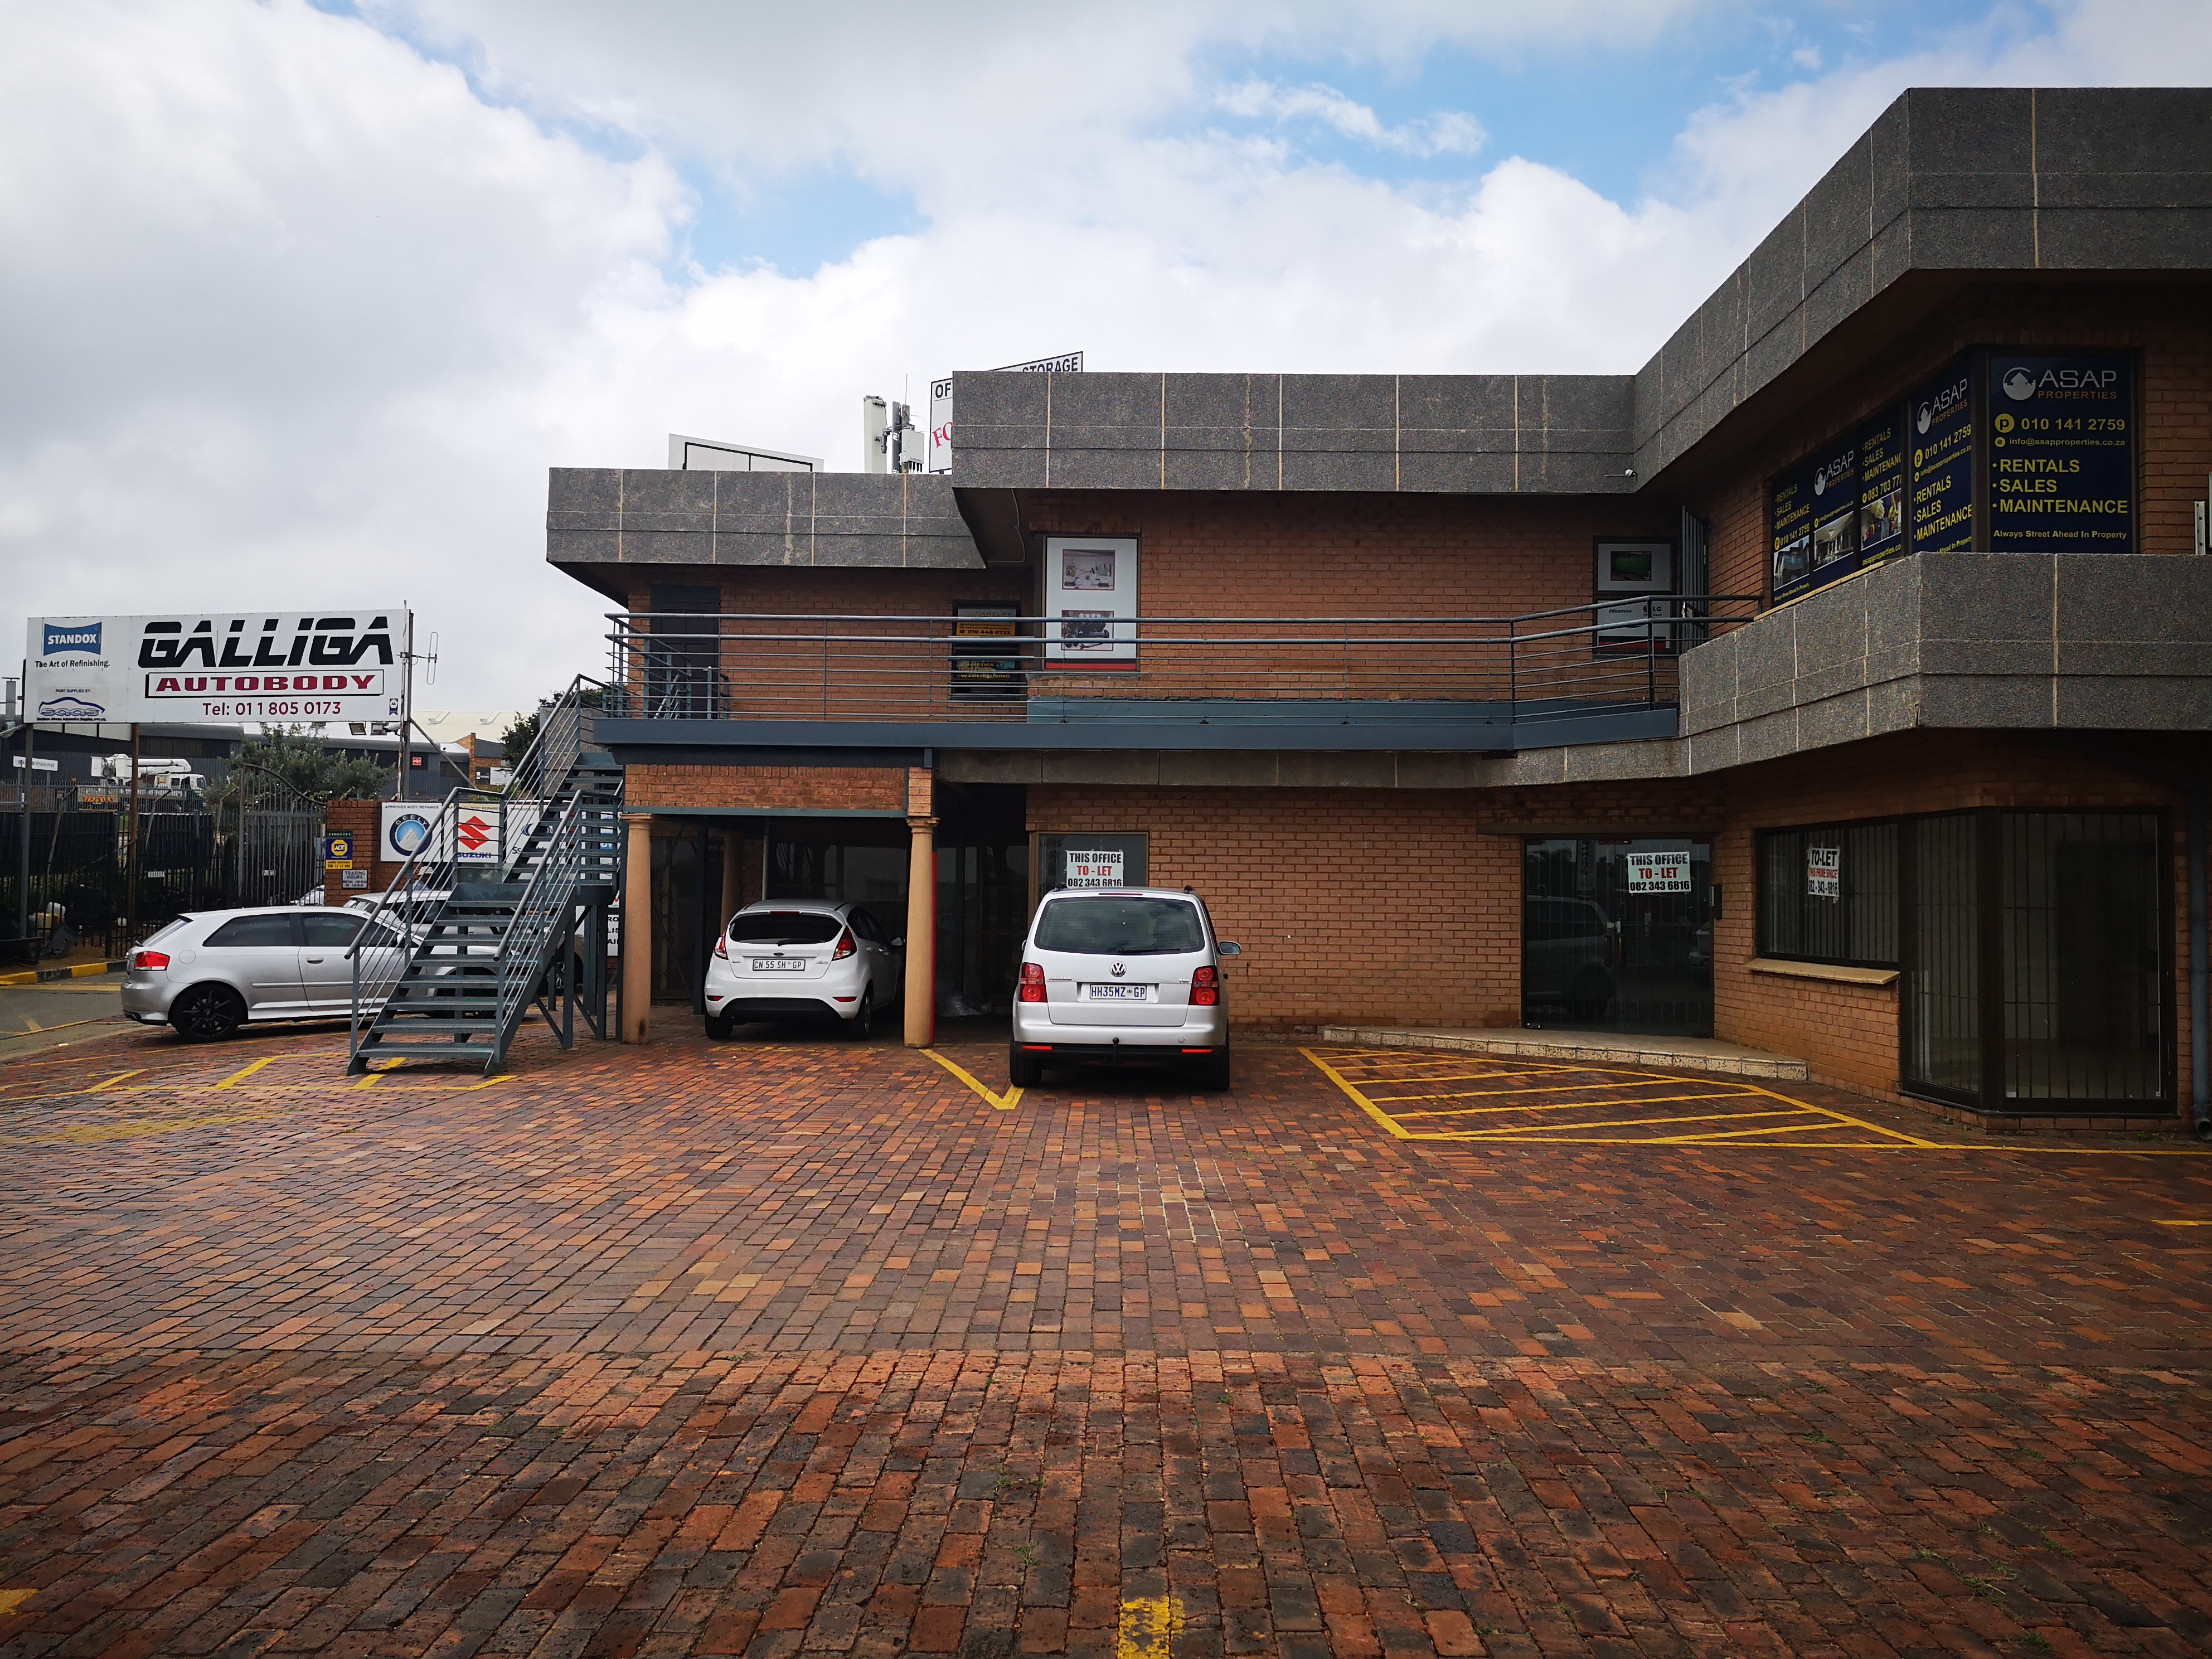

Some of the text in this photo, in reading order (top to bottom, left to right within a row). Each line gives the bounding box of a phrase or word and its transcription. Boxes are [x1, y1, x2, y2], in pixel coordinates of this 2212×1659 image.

[2038, 370, 2117, 389] ASAP
[1932, 378, 1968, 416] ASAP
[2038, 391, 2117, 400] PROPERTIES
[1932, 399, 1968, 426] PROPERTIES
[2021, 418, 2049, 430] 010
[2055, 418, 2081, 430] 141
[2088, 419, 2126, 431] 2759
[1865, 428, 1891, 452] RENTALS
[1925, 445, 1938, 459] 010
[1939, 437, 1952, 451] 141
[1953, 424, 1972, 444] 2759
[1865, 447, 1884, 467] SALES
[1826, 450, 1854, 481] ASAP
[2000, 459, 2080, 473] RENTALS
[1776, 483, 1798, 503] RENTALS
[1867, 486, 1879, 502] 083
[1880, 479, 1891, 494] 703
[1917, 475, 1952, 505] RENTALS
[2000, 479, 2058, 493] SALES
[1776, 501, 1792, 517] SALES
[1917, 499, 1942, 522] SALES
[2000, 499, 2128, 513] MAINTENANCE
[1776, 503, 1810, 531] MAINTENANCE
[1917, 504, 1972, 541] MAINTENANCE
[1780, 534, 1789, 546] 010
[1798, 523, 1810, 539] 2759
[1993, 530, 2023, 539] Always
[2092, 531, 2127, 540] Property
[47, 634, 97, 644] STANDOX
[138, 616, 394, 668] GALLIGA
[156, 675, 376, 692] AUTOBODY
[202, 702, 230, 716] Tel:
[268, 702, 298, 715] 805
[304, 701, 341, 715] 0173
[395, 814, 428, 826] GEELY
[1069, 853, 1122, 864] THIS OFFICE
[1629, 854, 1688, 866] THIS OFFICE
[1076, 865, 1089, 876] TO
[1097, 866, 1113, 876] LET
[1638, 868, 1652, 879] TO
[1661, 867, 1678, 879] LET
[1068, 878, 1083, 887] 082
[1085, 878, 1100, 887] 343
[1629, 880, 1690, 891] 082 343 6816
[754, 961, 763, 969] CN
[765, 961, 774, 969] 55
[1092, 986, 1145, 998] HH35MZ GP
